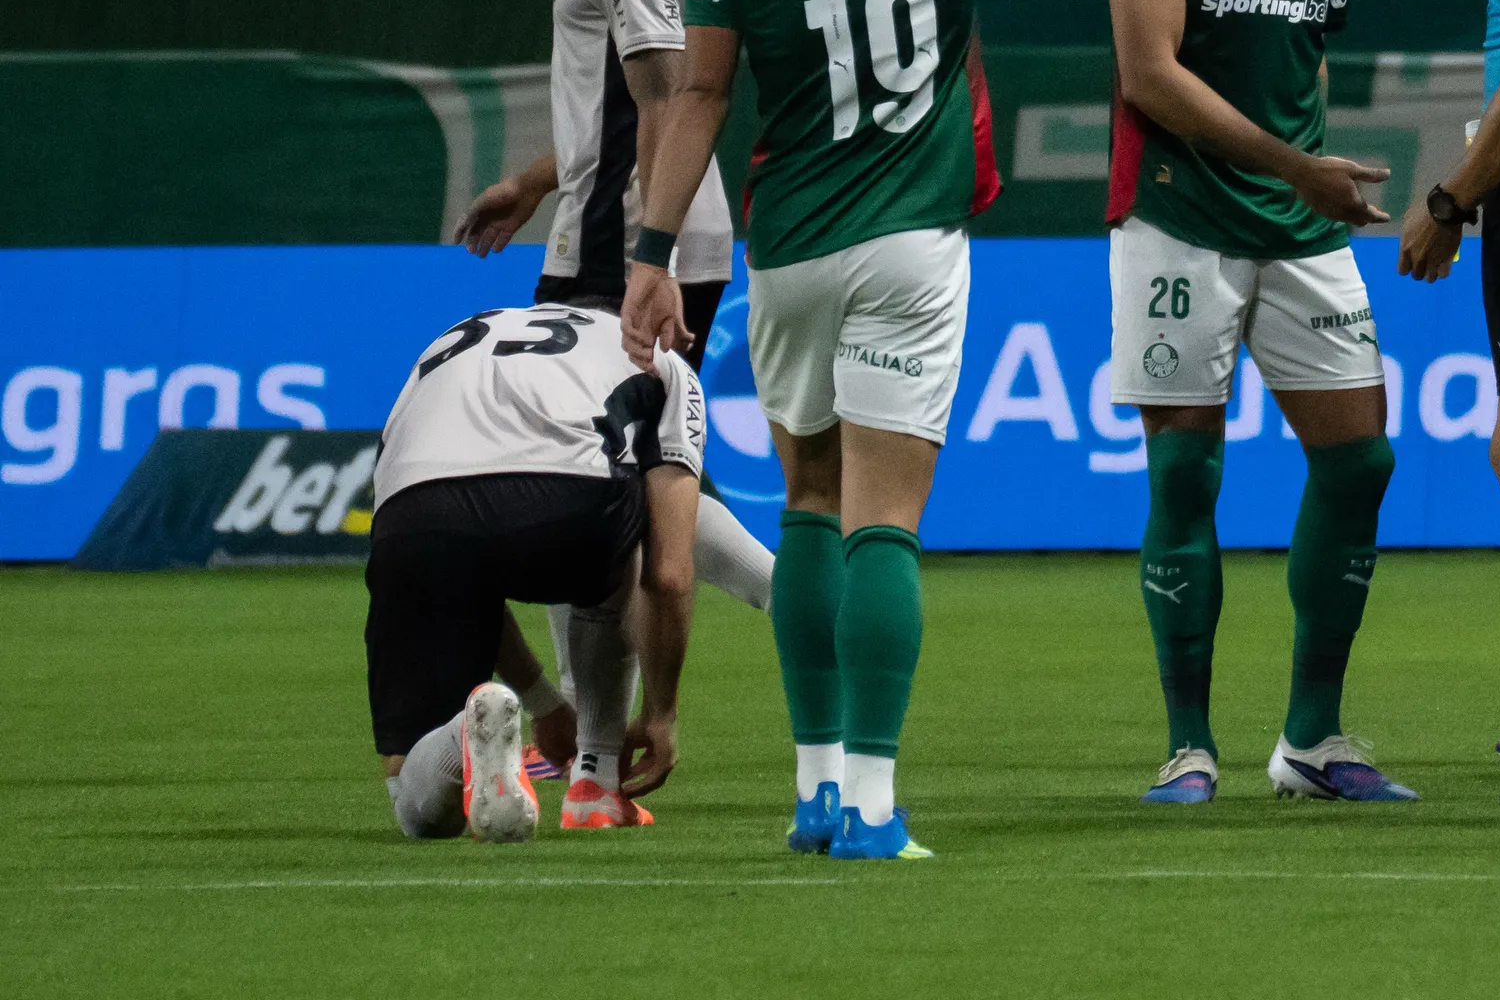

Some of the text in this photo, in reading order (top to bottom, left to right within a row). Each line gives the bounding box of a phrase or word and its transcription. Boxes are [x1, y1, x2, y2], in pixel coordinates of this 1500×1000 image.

[1148, 276, 1191, 319] 26
[686, 366, 702, 448] AVAN
[212, 434, 378, 534] bet
